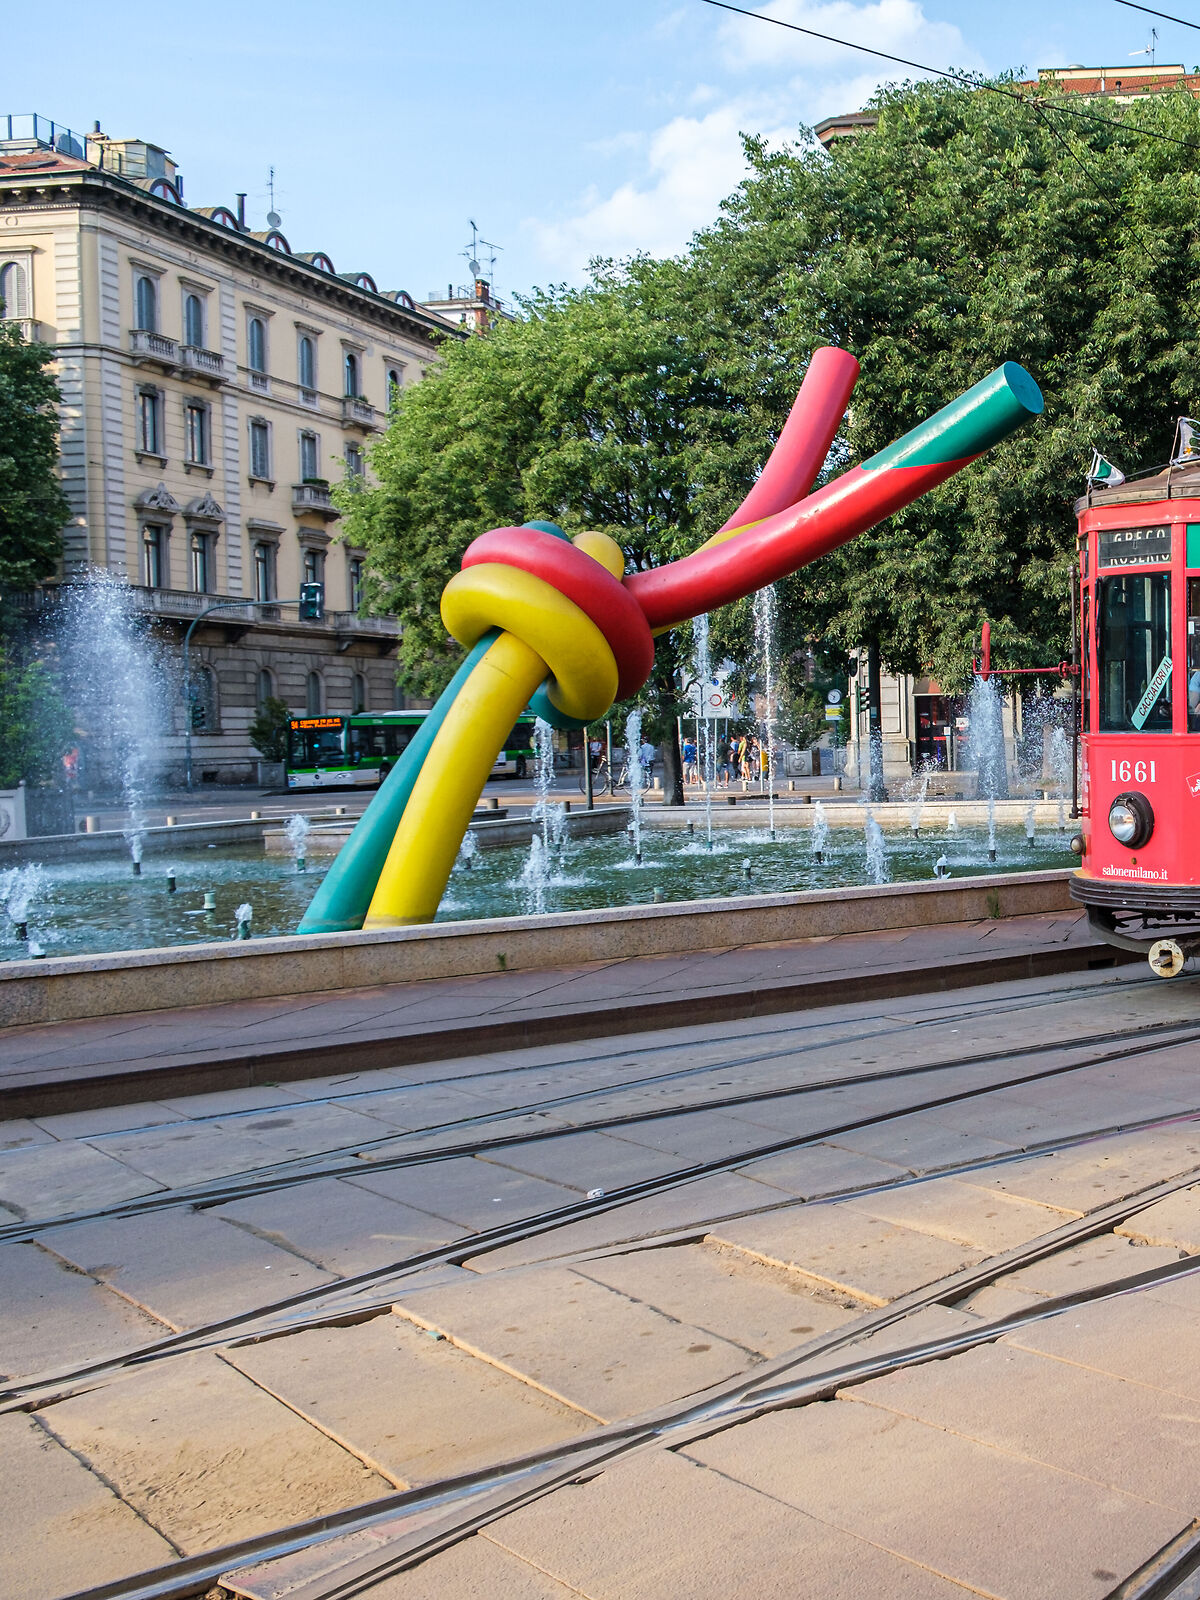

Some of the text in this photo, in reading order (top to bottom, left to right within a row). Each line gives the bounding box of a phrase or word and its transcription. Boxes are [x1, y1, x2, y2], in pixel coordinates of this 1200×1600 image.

[1138, 668, 1167, 717] CACCIATORI
[1111, 760, 1156, 783] 1661
[1102, 865, 1168, 880] salonemilano.it
